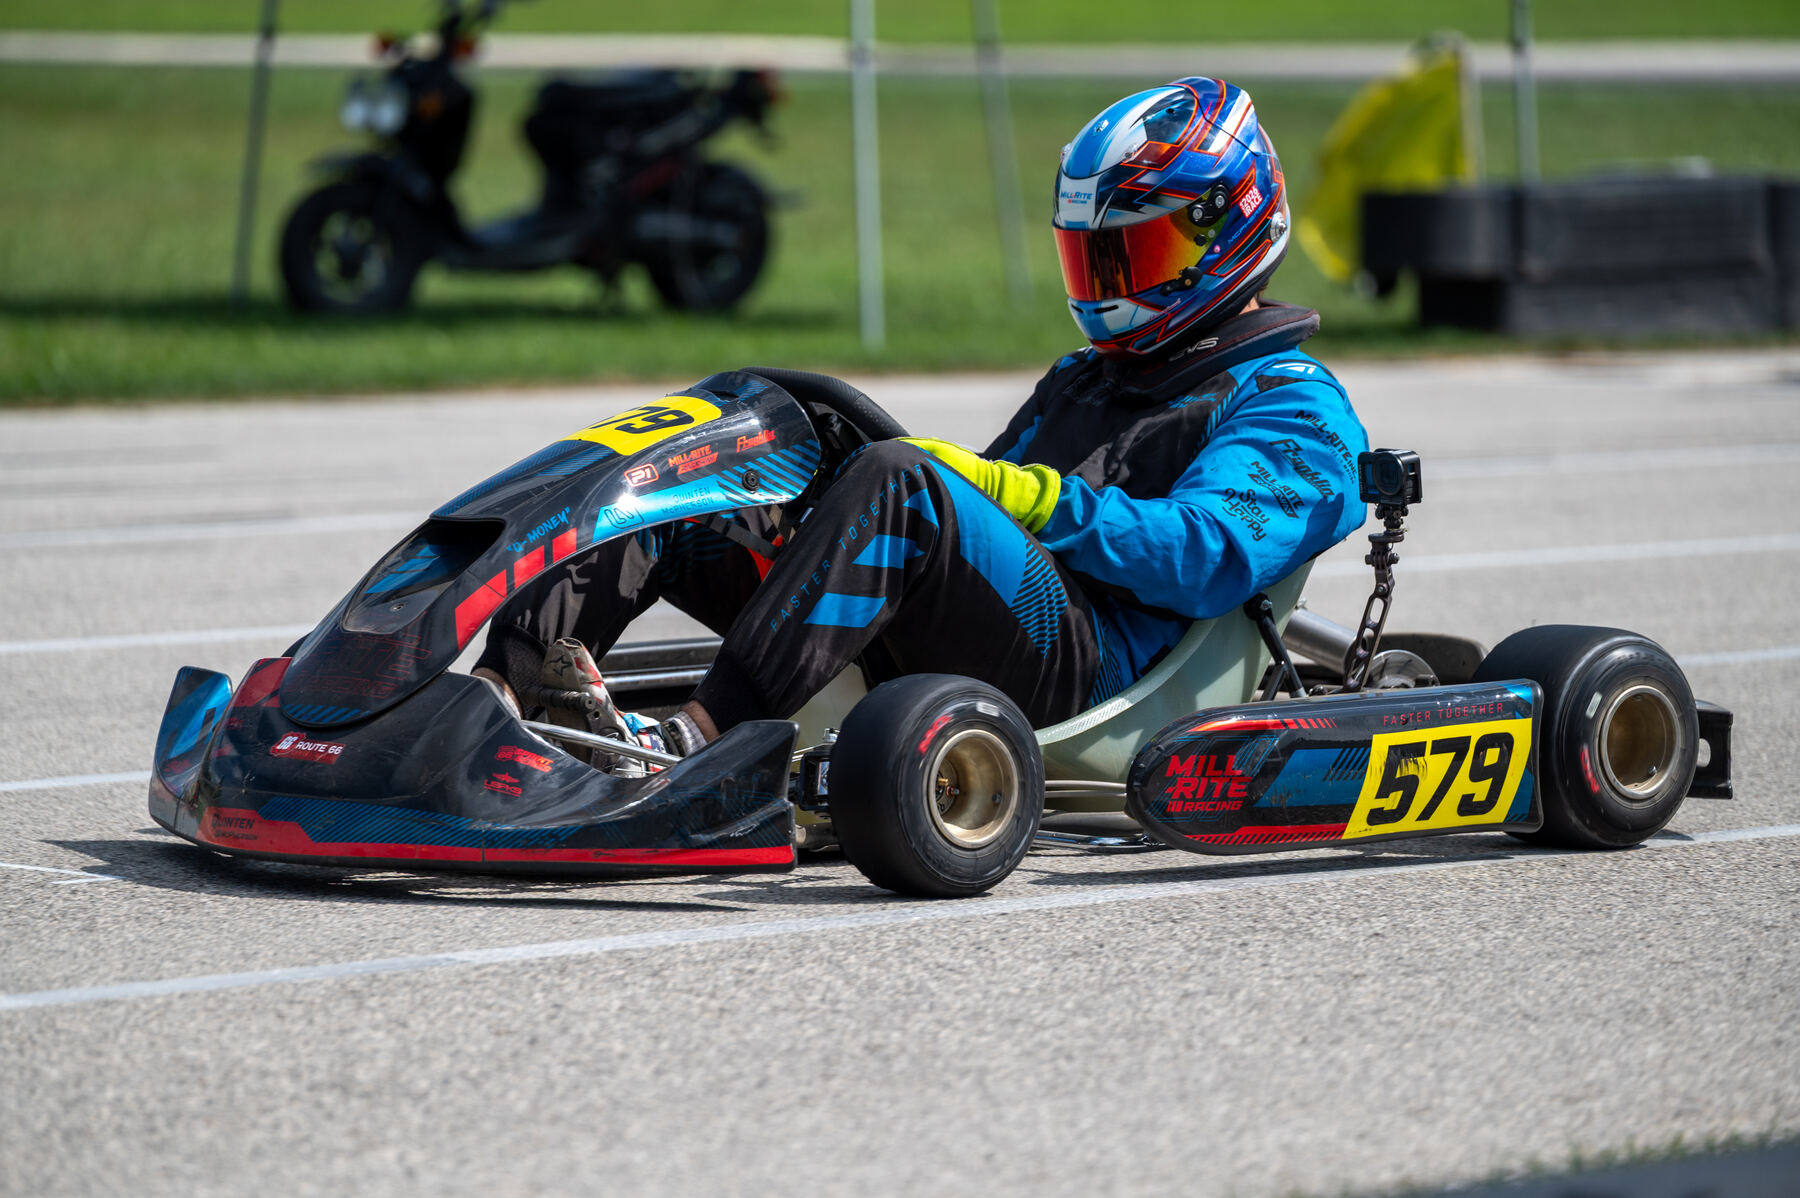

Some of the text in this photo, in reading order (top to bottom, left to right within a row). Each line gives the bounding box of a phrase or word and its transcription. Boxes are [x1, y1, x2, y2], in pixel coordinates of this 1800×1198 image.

[1221, 487, 1267, 541] Happy
[1239, 489, 1270, 524] Stay
[769, 463, 921, 632] FASTER TOGETHER
[1383, 702, 1504, 726] FASTER TOGETHER
[295, 741, 328, 753] ROUTE
[328, 745, 343, 755] 66
[1165, 754, 1242, 777] MILL
[1366, 731, 1514, 827] 579
[1183, 800, 1243, 812] RACING
